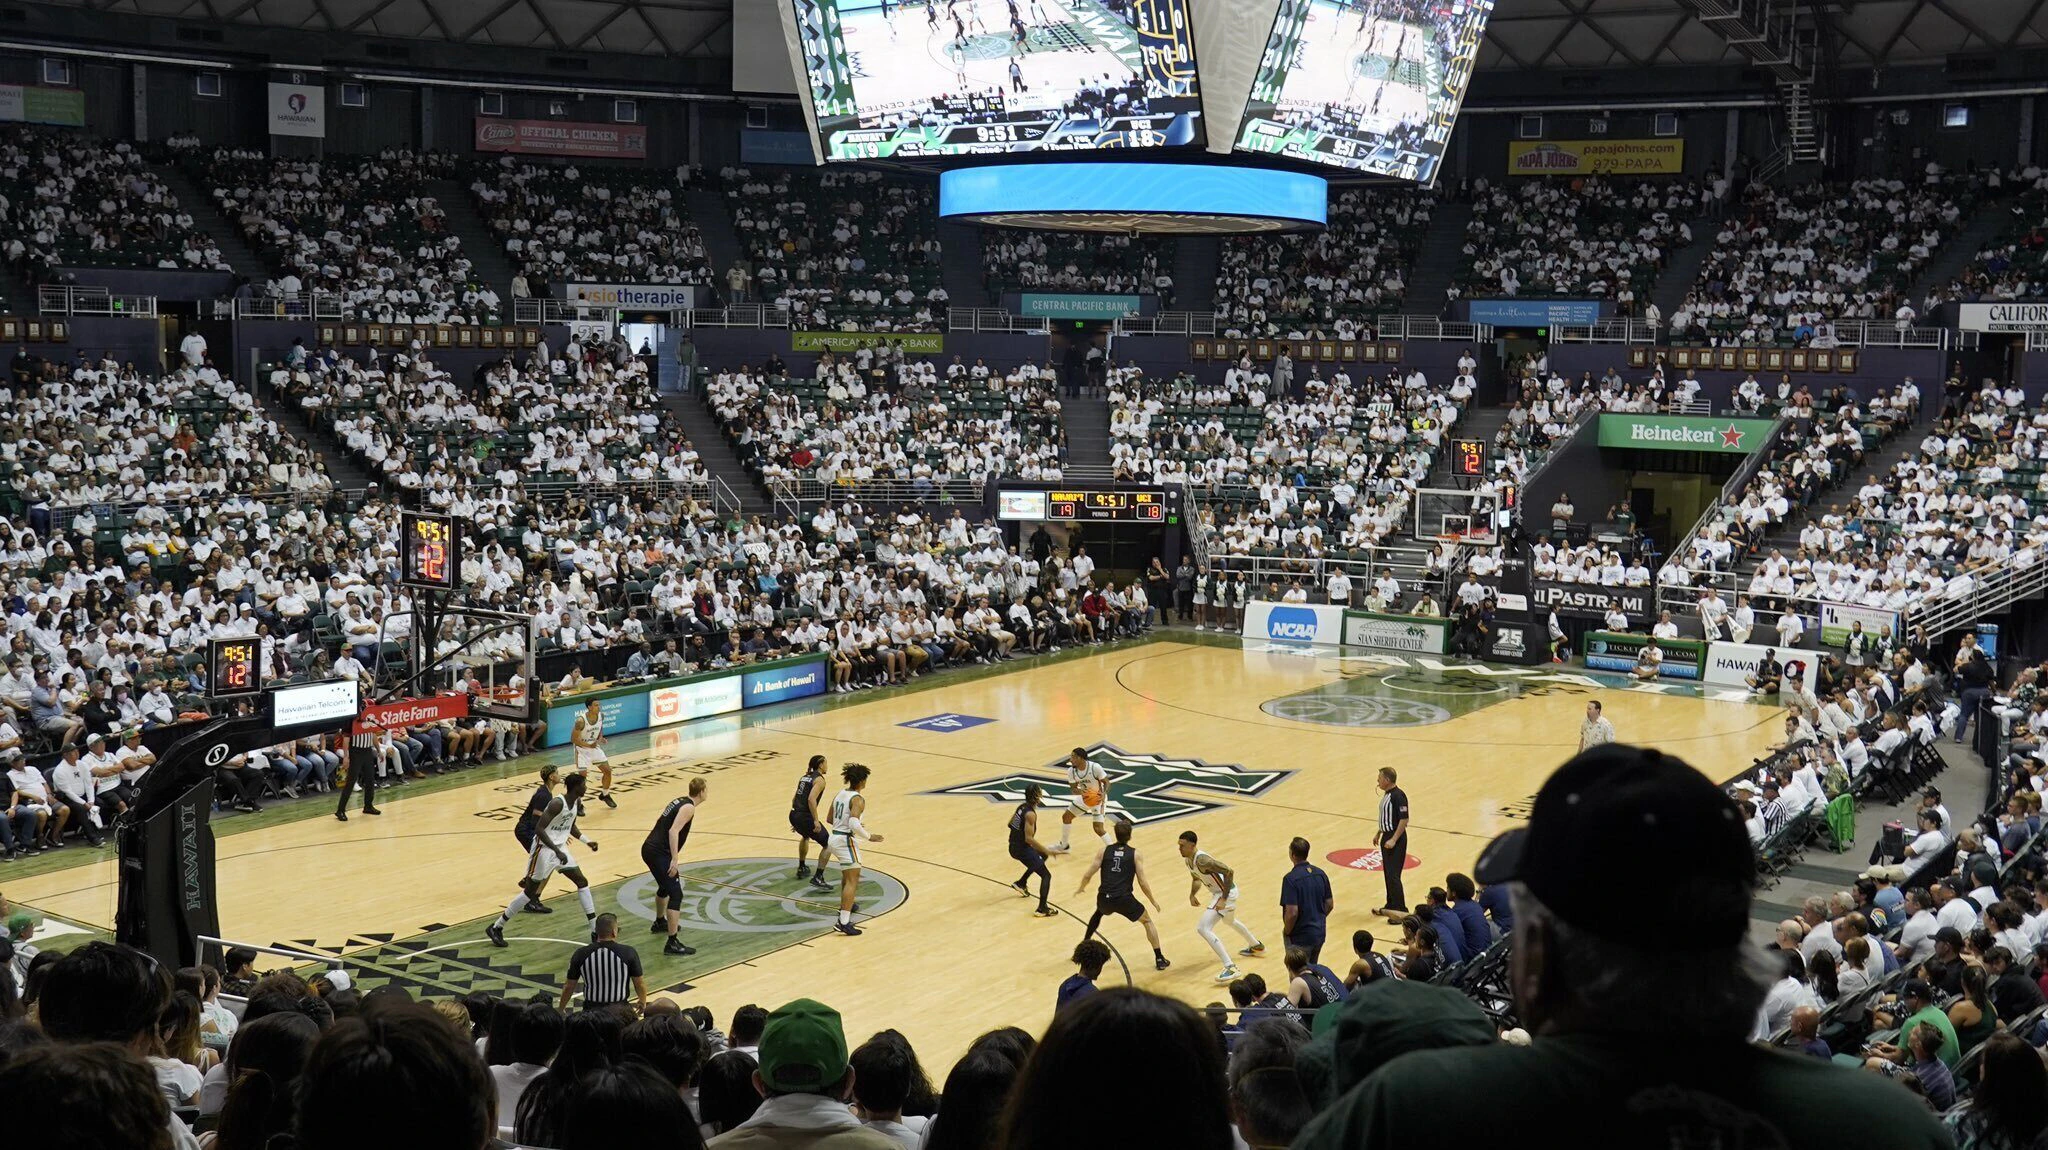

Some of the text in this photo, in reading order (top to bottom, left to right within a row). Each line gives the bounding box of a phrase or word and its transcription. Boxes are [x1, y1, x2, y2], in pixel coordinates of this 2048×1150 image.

[1159, 10, 1167, 30] 1
[1174, 9, 1183, 29] 0
[804, 37, 842, 56] 10 0 0
[1140, 44, 1187, 66] 15 0 0
[809, 68, 849, 86] 23 0 4
[1146, 80, 1163, 98] 22
[1168, 79, 1176, 97] 0
[816, 98, 854, 117] 32 0 0
[521, 126, 618, 142] OFFICIAL CHICKEN
[977, 125, 1018, 142] 9:51
[1129, 130, 1154, 147] 18
[857, 142, 879, 158] 19
[1583, 143, 1675, 155] papajohns.com
[1517, 154, 1542, 168] PAPA
[1593, 158, 1663, 170] 979-PAPA
[1032, 300, 1129, 311] CENTRAL PACIFIC BANK
[812, 338, 864, 347] AMERICAN
[909, 338, 938, 348] BANK
[1631, 424, 1715, 443] Heineken
[1461, 443, 1482, 453] 9:51
[1465, 454, 1479, 472] 12
[1096, 494, 1124, 507] 9:51
[1136, 494, 1152, 503] UCI
[1060, 505, 1159, 517] 19 18
[417, 520, 449, 541] 9:51
[424, 544, 445, 579] 12
[1271, 621, 1317, 638] NCAA
[1497, 627, 1524, 646] 25
[1358, 633, 1423, 651] STAN SHERIFF CENTER
[224, 645, 252, 662] 9:51
[1716, 658, 1759, 673] HAWAI
[229, 664, 246, 685] 12
[765, 681, 780, 692] Bank
[782, 679, 790, 689] of
[278, 699, 346, 714] Hawaiian Telcom
[381, 706, 438, 726] State Farm
[679, 750, 790, 775] CENTER
[1111, 857, 1121, 872] 1
